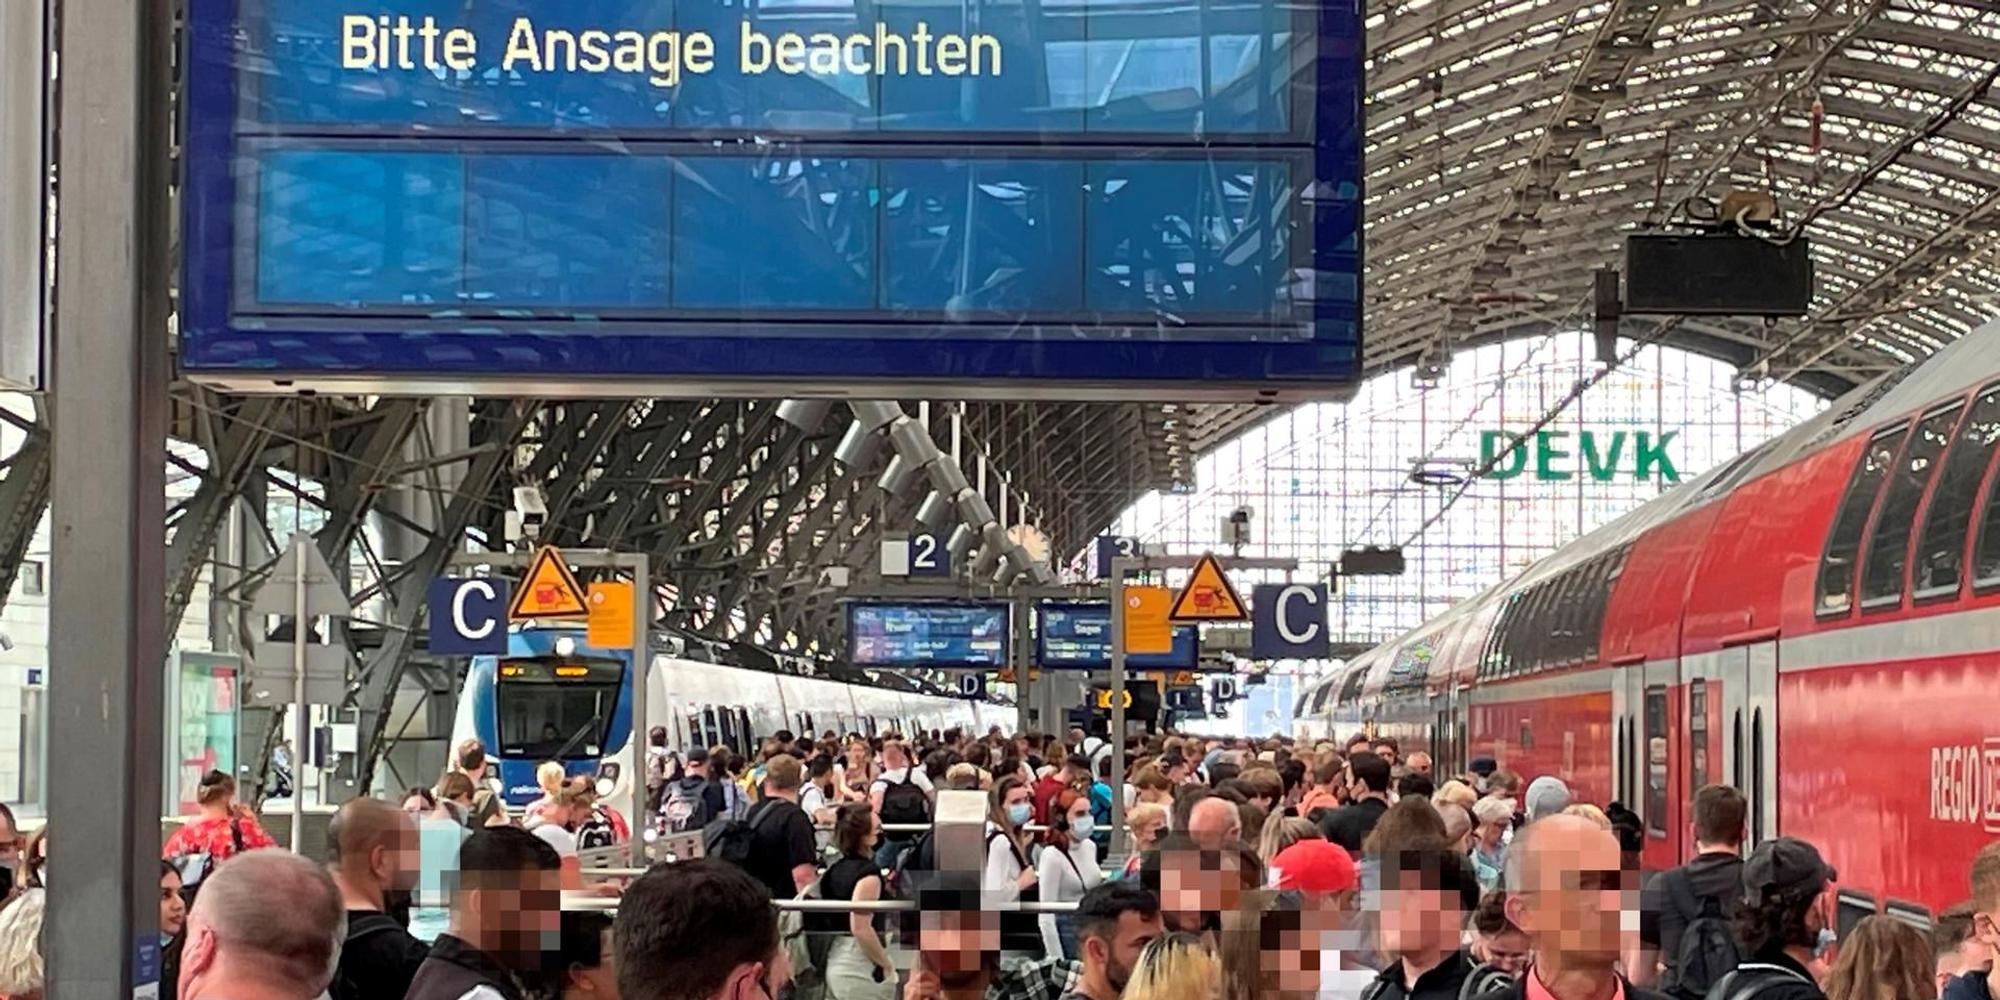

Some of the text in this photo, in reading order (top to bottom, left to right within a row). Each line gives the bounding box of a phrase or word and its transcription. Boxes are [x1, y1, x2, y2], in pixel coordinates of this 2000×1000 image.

[342, 15, 1001, 87] Bitte Ansage beachten
[1480, 429, 1681, 482] DEVK
[914, 534, 936, 568] 2
[1113, 537, 1134, 559] 3
[452, 580, 496, 640] C
[1275, 584, 1319, 644] C
[963, 674, 979, 696] D
[1218, 679, 1235, 699] D
[1930, 745, 1981, 823] REGIO
